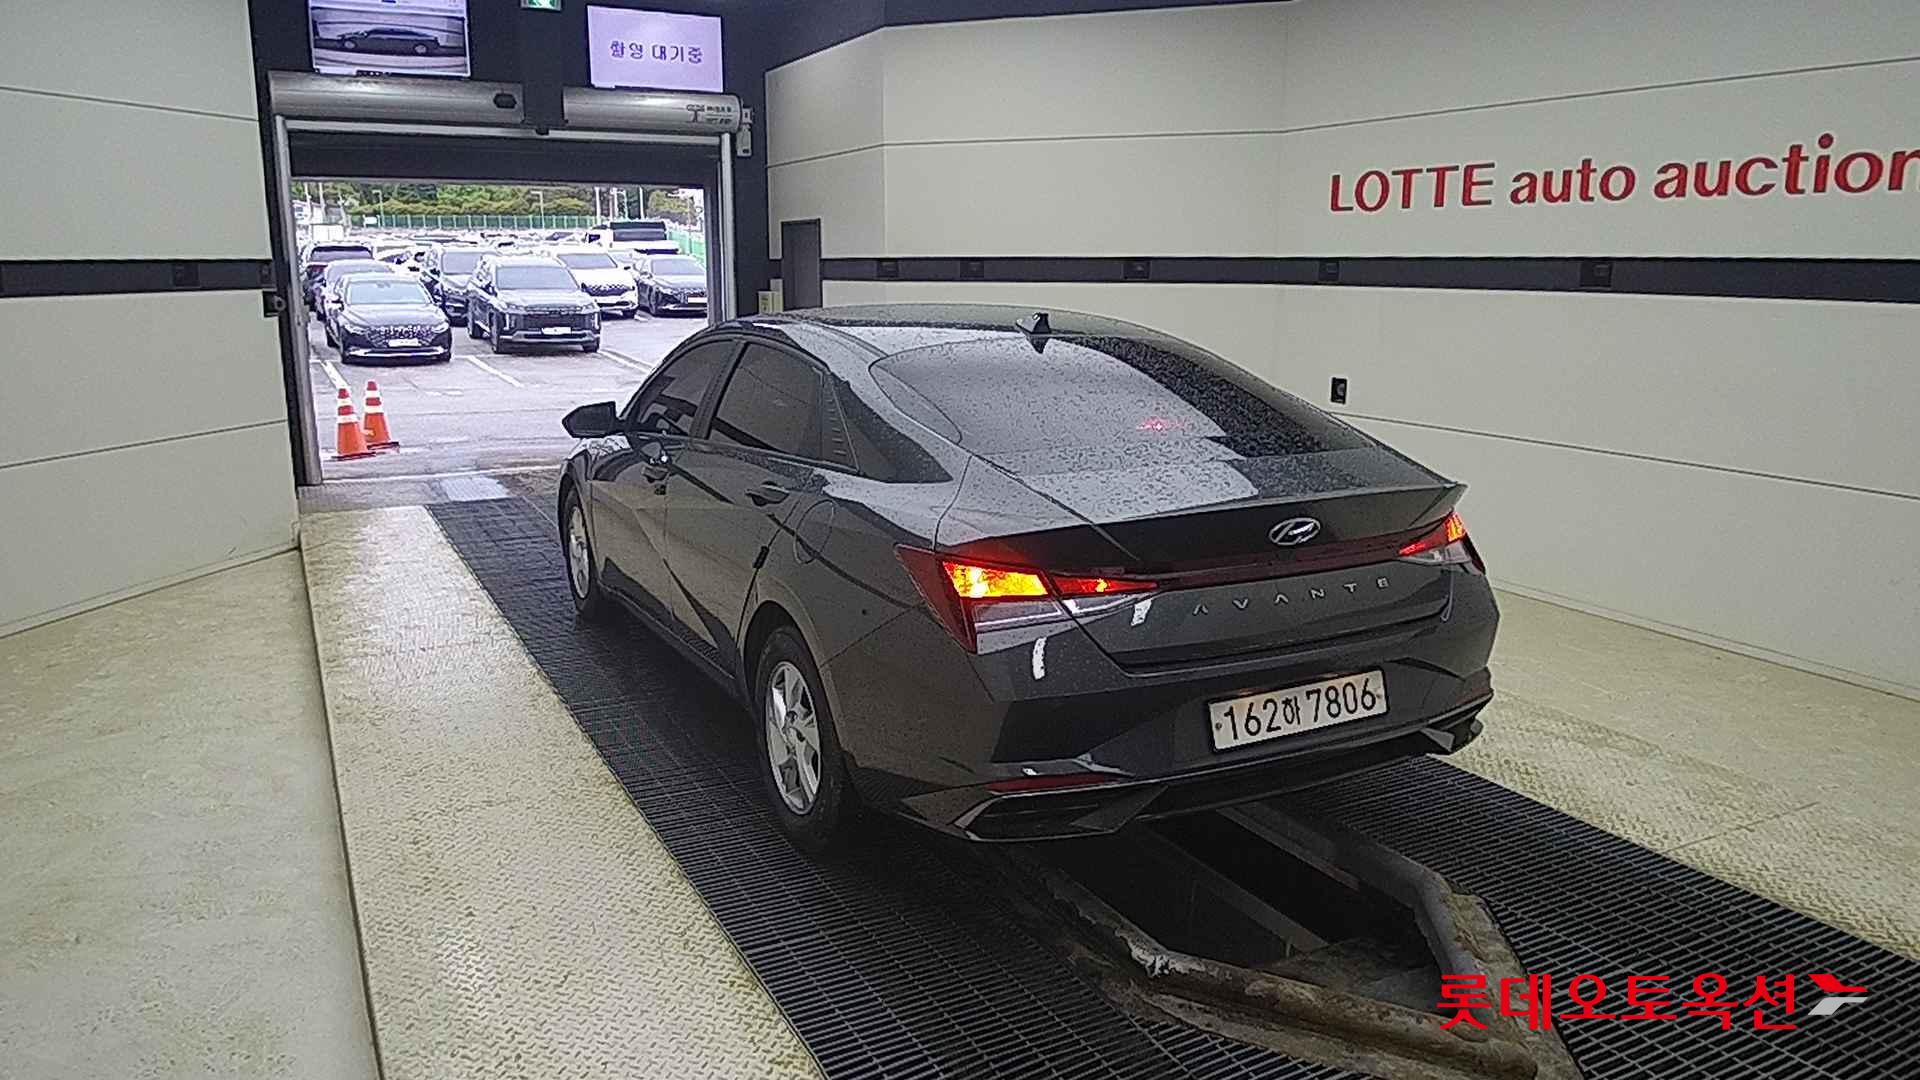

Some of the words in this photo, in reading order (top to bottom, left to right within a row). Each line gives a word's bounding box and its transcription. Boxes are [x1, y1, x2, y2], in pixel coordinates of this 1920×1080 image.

[651, 45, 704, 65] 대기중
[1330, 161, 1496, 213] LOTTE
[1509, 157, 1637, 206] auto
[1192, 576, 1390, 616] AVANTE
[1223, 696, 1301, 741] 162하
[1305, 677, 1377, 723] 7806
